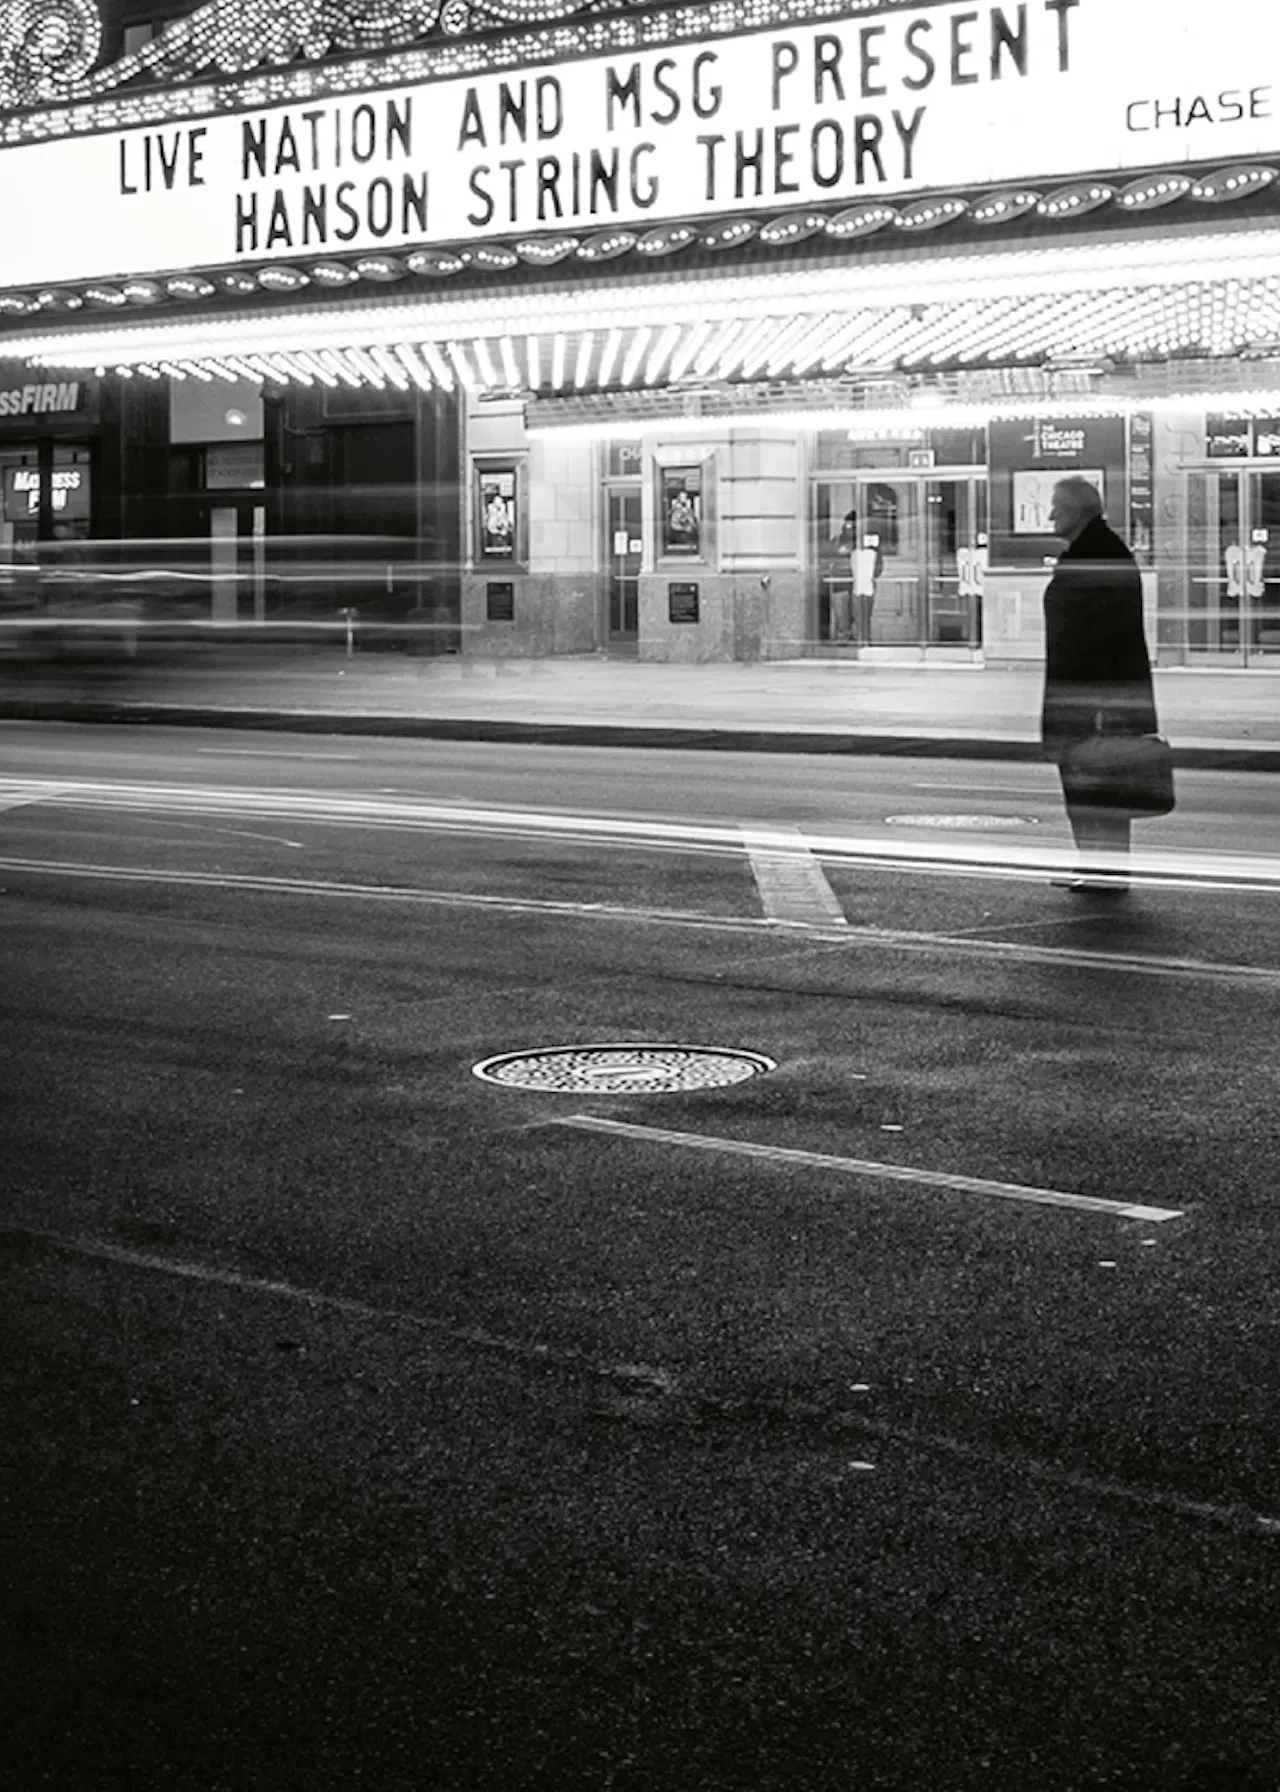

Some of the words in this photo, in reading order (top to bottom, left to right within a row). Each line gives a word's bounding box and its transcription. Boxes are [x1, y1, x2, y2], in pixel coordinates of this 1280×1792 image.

[119, 126, 208, 196] LIVE
[241, 96, 414, 181] NATION
[458, 74, 564, 152] AND
[606, 49, 724, 131] MSG
[1125, 84, 1275, 132] CHASE
[235, 172, 429, 254] HANSON
[467, 143, 661, 227] STRING
[696, 105, 927, 201] THEORY
[1041, 430, 1085, 440] CHICAGO
